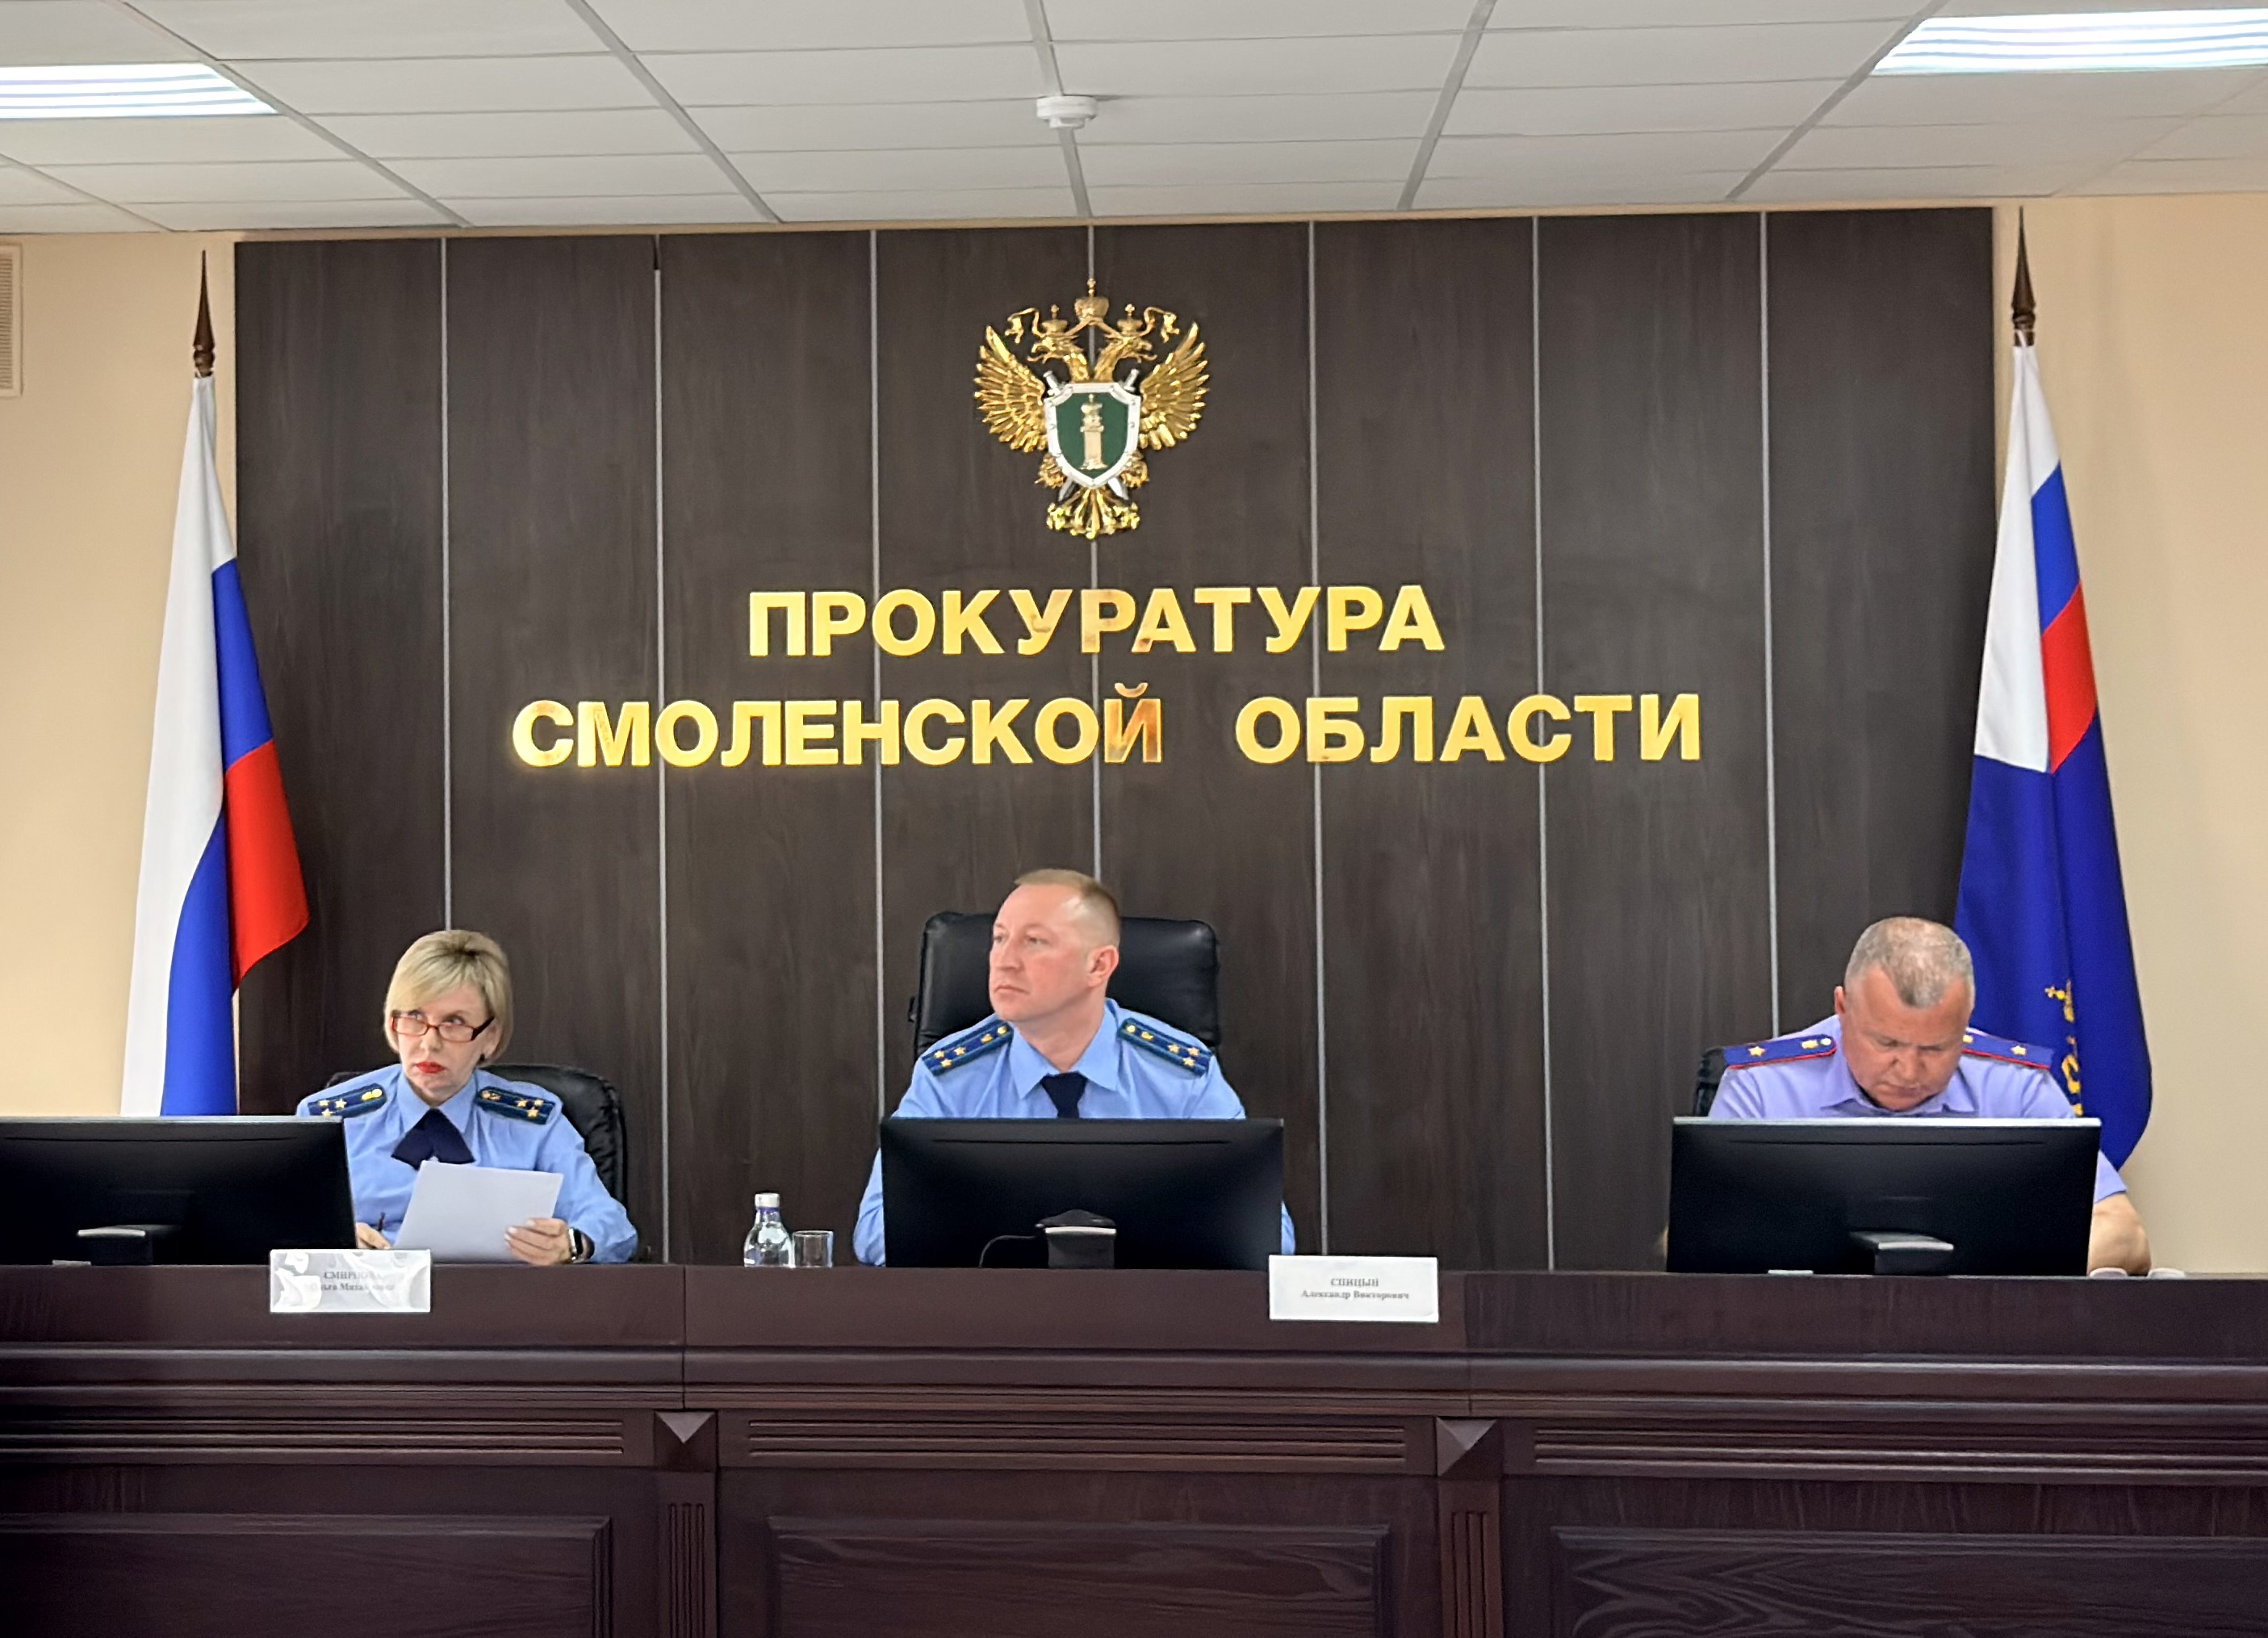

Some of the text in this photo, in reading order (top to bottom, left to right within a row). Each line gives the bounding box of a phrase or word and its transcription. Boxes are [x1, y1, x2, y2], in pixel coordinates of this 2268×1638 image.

[747, 584, 1446, 660] ПРОКУРАТУРА
[512, 682, 1701, 769] СМОЛЕНСКОЙ ОБЛАСТИ
[1301, 1290, 1409, 1301] Александр Викторович
[1330, 1278, 1379, 1287] СПИЦЫН
